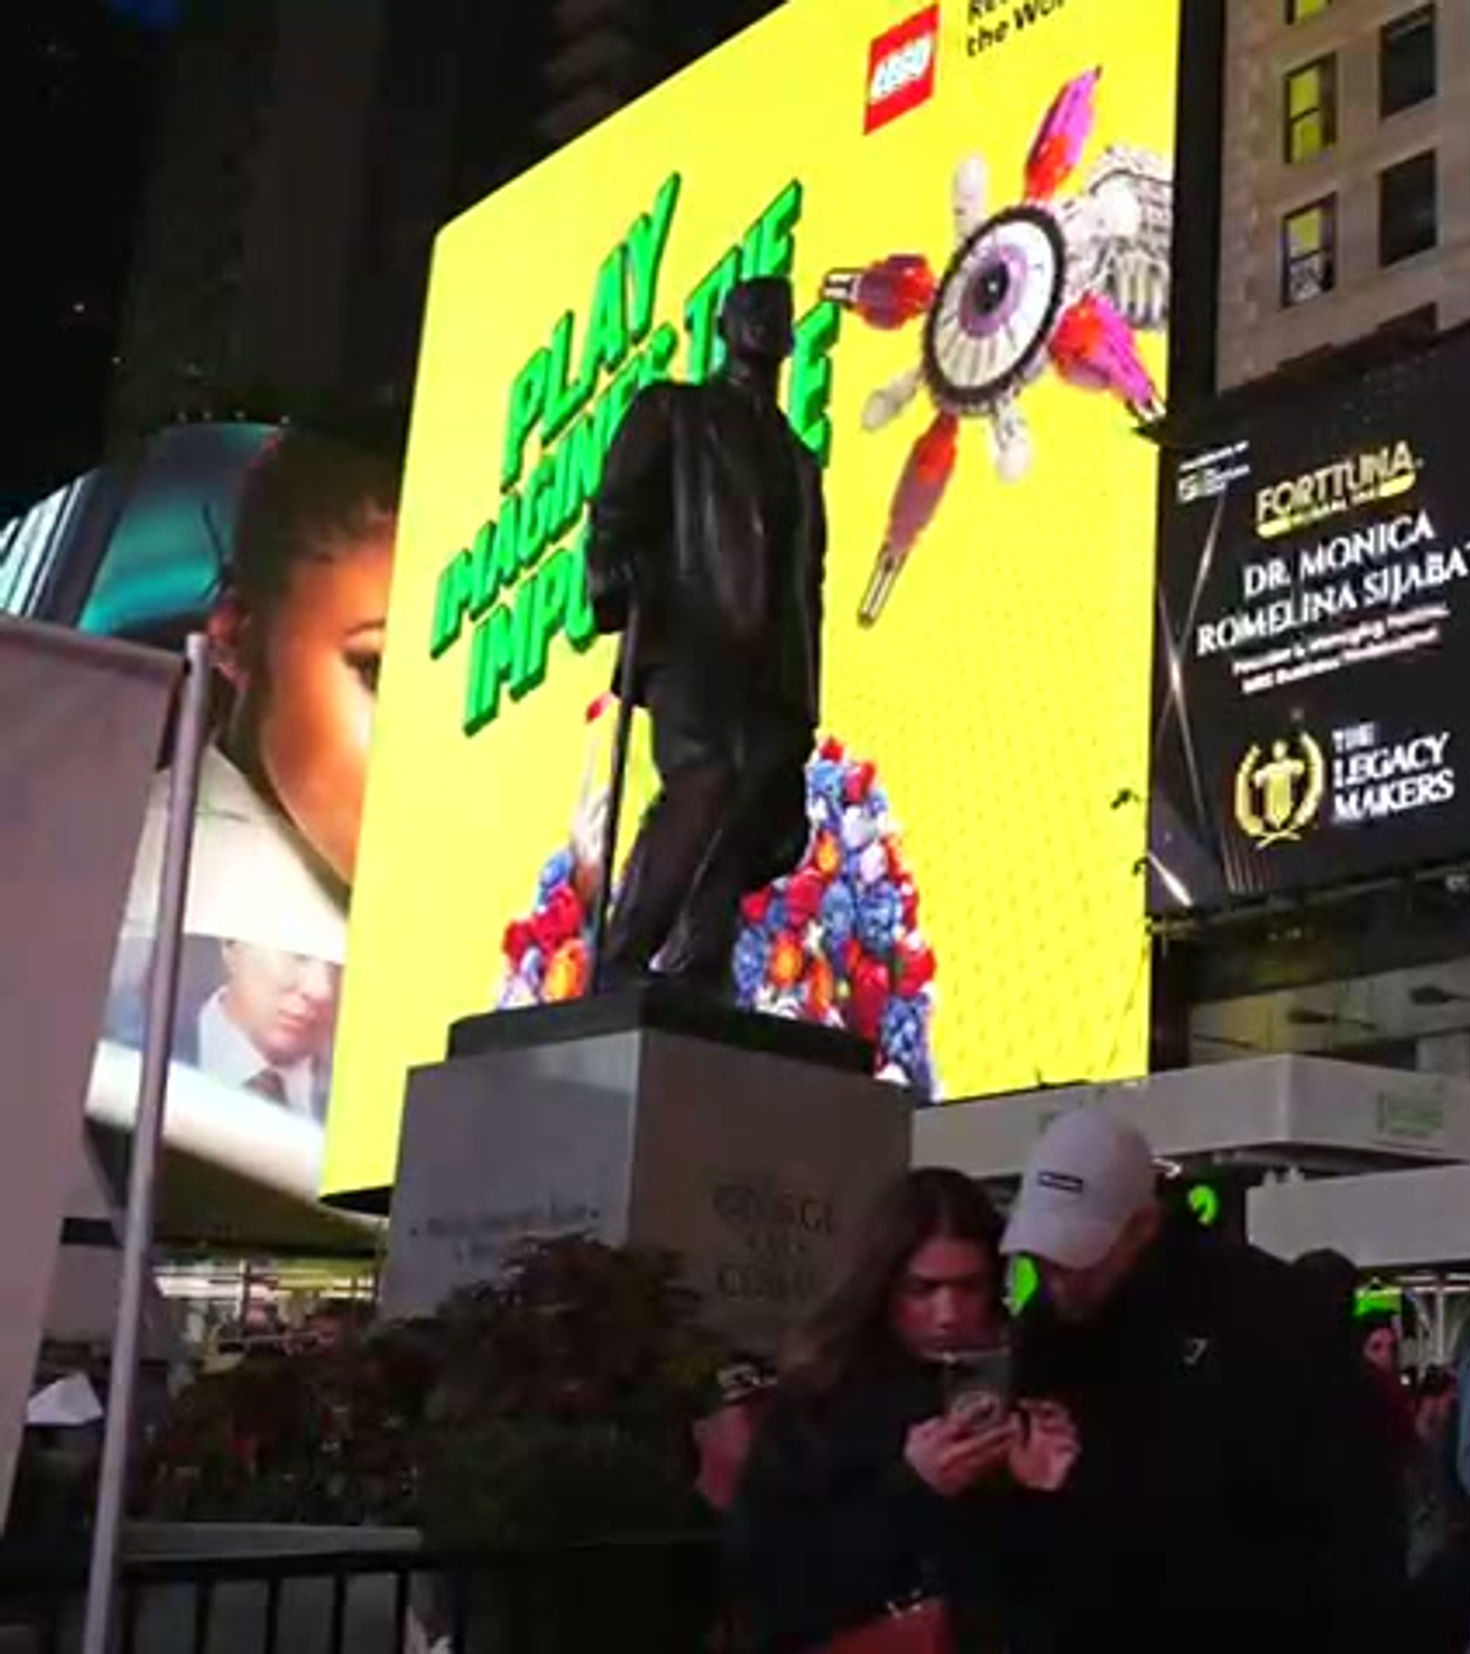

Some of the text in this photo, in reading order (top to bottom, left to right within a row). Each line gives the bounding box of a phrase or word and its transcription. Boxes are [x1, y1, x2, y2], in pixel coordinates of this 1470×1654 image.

[967, 21, 1009, 57] the
[1013, 0, 1064, 30] Wo
[684, 177, 803, 382] TE
[501, 171, 681, 495] PLAY
[1302, 510, 1437, 578] MONICA
[1197, 587, 1358, 656] ROMELINA
[1333, 731, 1450, 788] LEGACY
[1333, 767, 1455, 822] MAKERS
